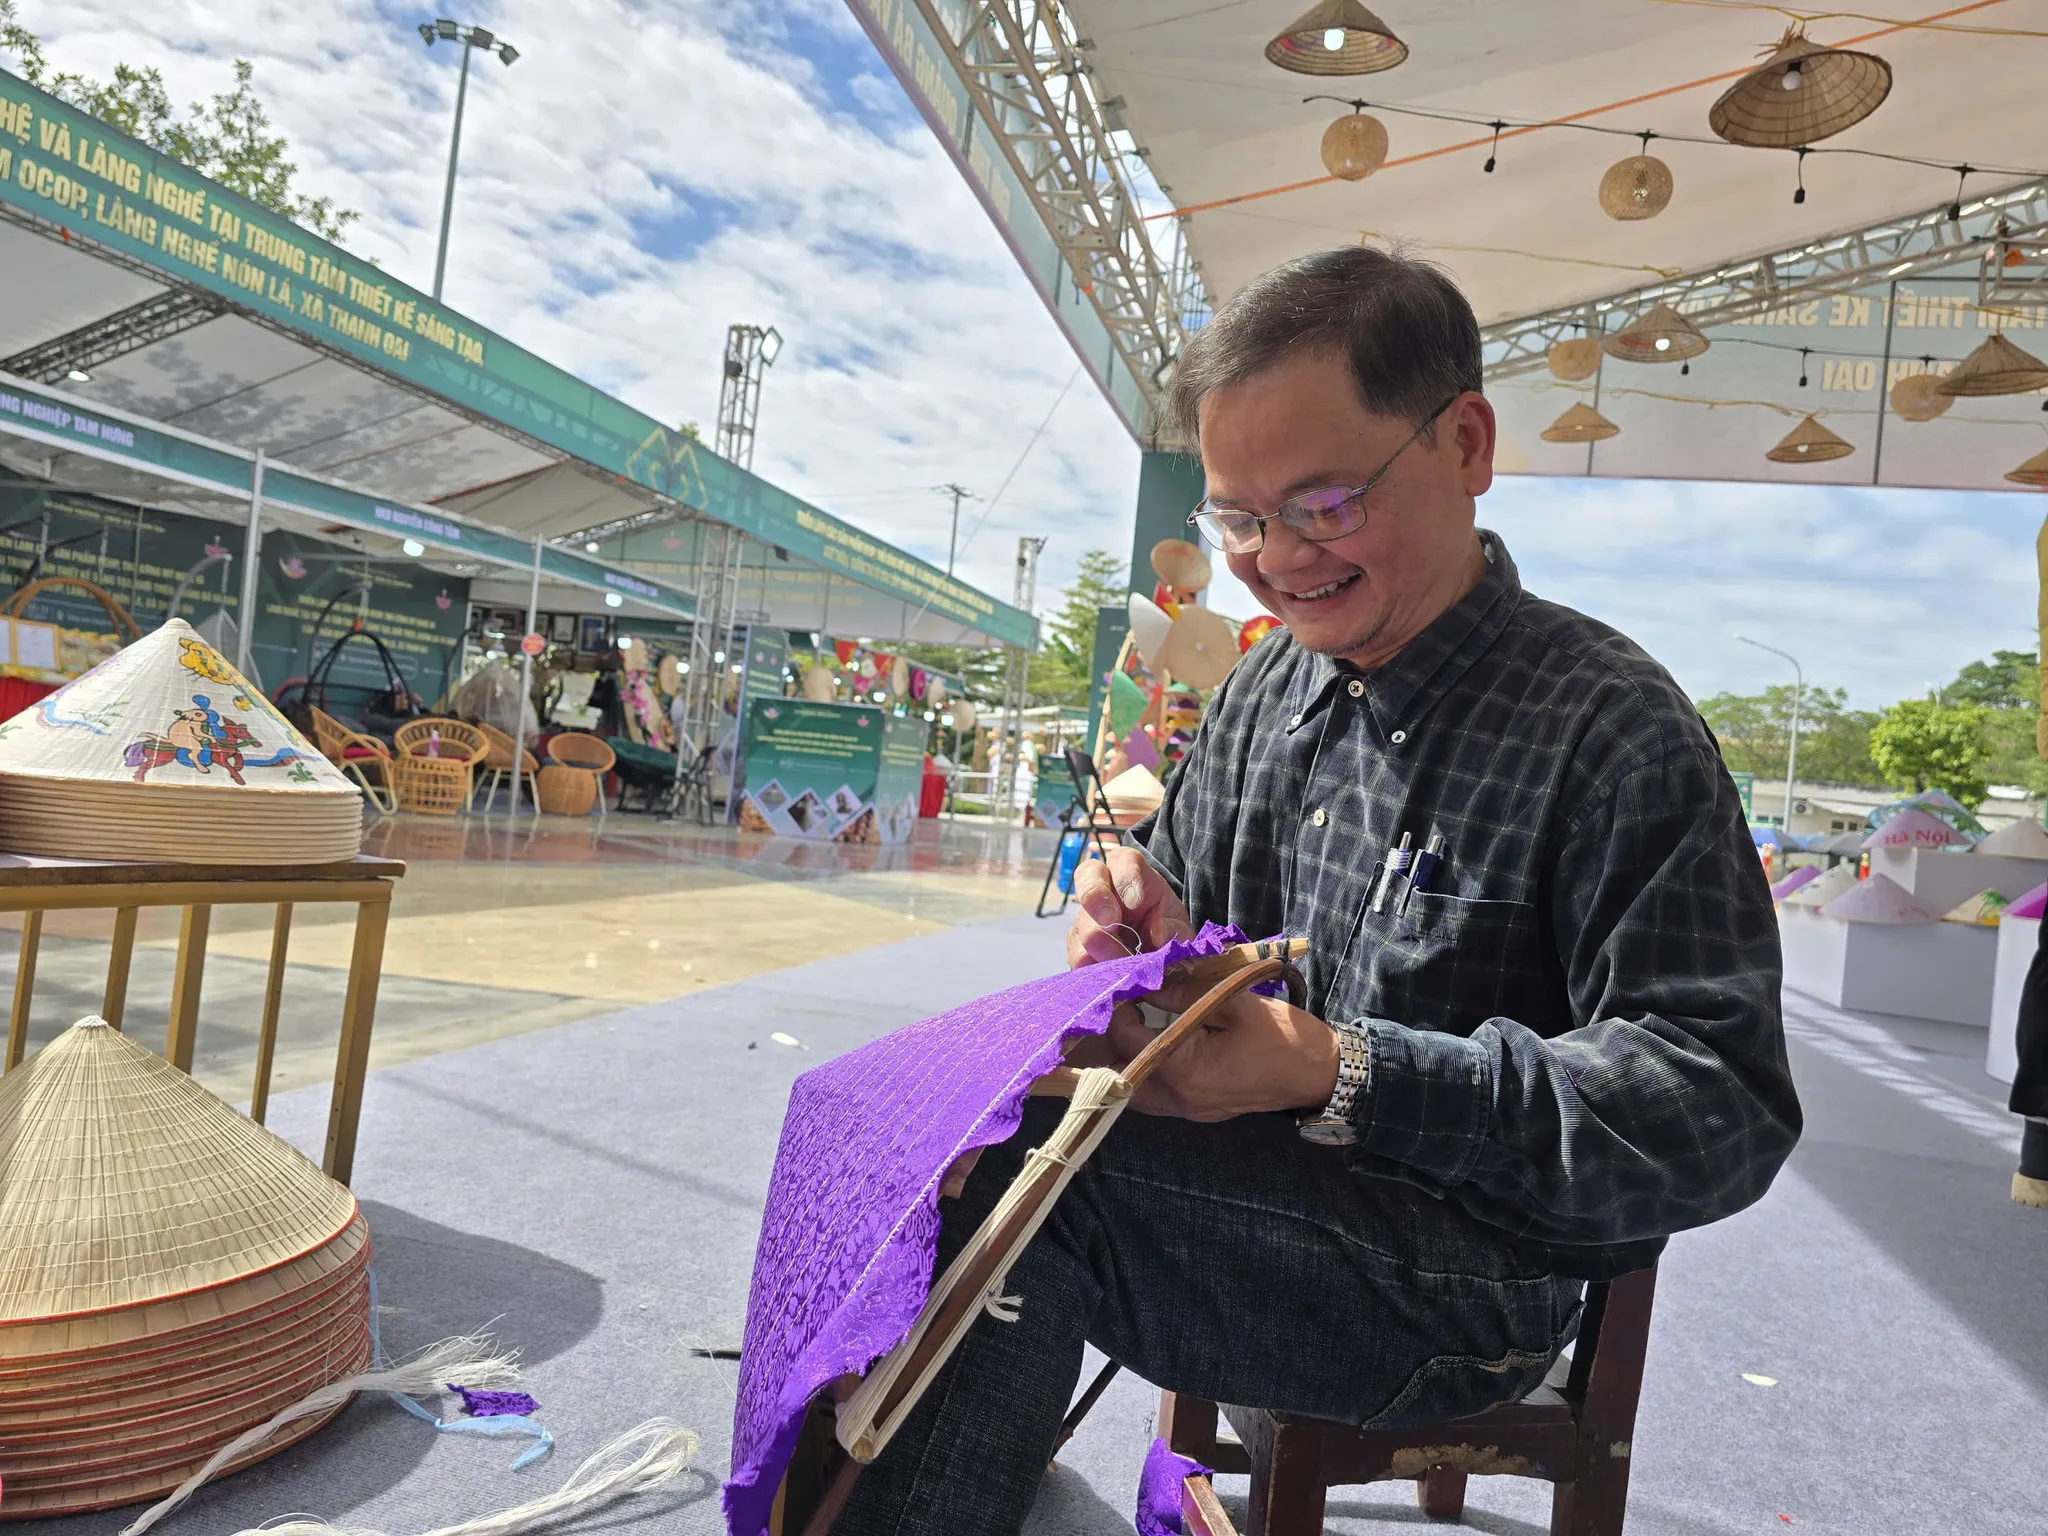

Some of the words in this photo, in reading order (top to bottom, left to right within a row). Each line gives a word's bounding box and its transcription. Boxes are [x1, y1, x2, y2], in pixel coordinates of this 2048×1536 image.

[18, 159, 88, 219] OCOP,
[96, 193, 157, 246] LÀNG
[161, 224, 220, 274] NGHỀ
[222, 253, 266, 296] NÓN
[268, 275, 295, 314] LÁ,
[300, 291, 324, 323] XÃ
[328, 304, 381, 349] THANH
[383, 332, 410, 362] OAI
[40, 118, 71, 161] VÀ
[78, 138, 142, 194] LÀNG
[145, 172, 206, 225] NGHỀ
[209, 203, 241, 243] TẠI
[245, 222, 306, 275] TRUNG
[309, 255, 347, 295] TÂM
[349, 275, 393, 317] THIẾT
[393, 300, 417, 330] KẾ
[416, 313, 456, 350] SÁNG
[1884, 829, 1909, 845] Hà
[1914, 828, 1949, 845] Nội
